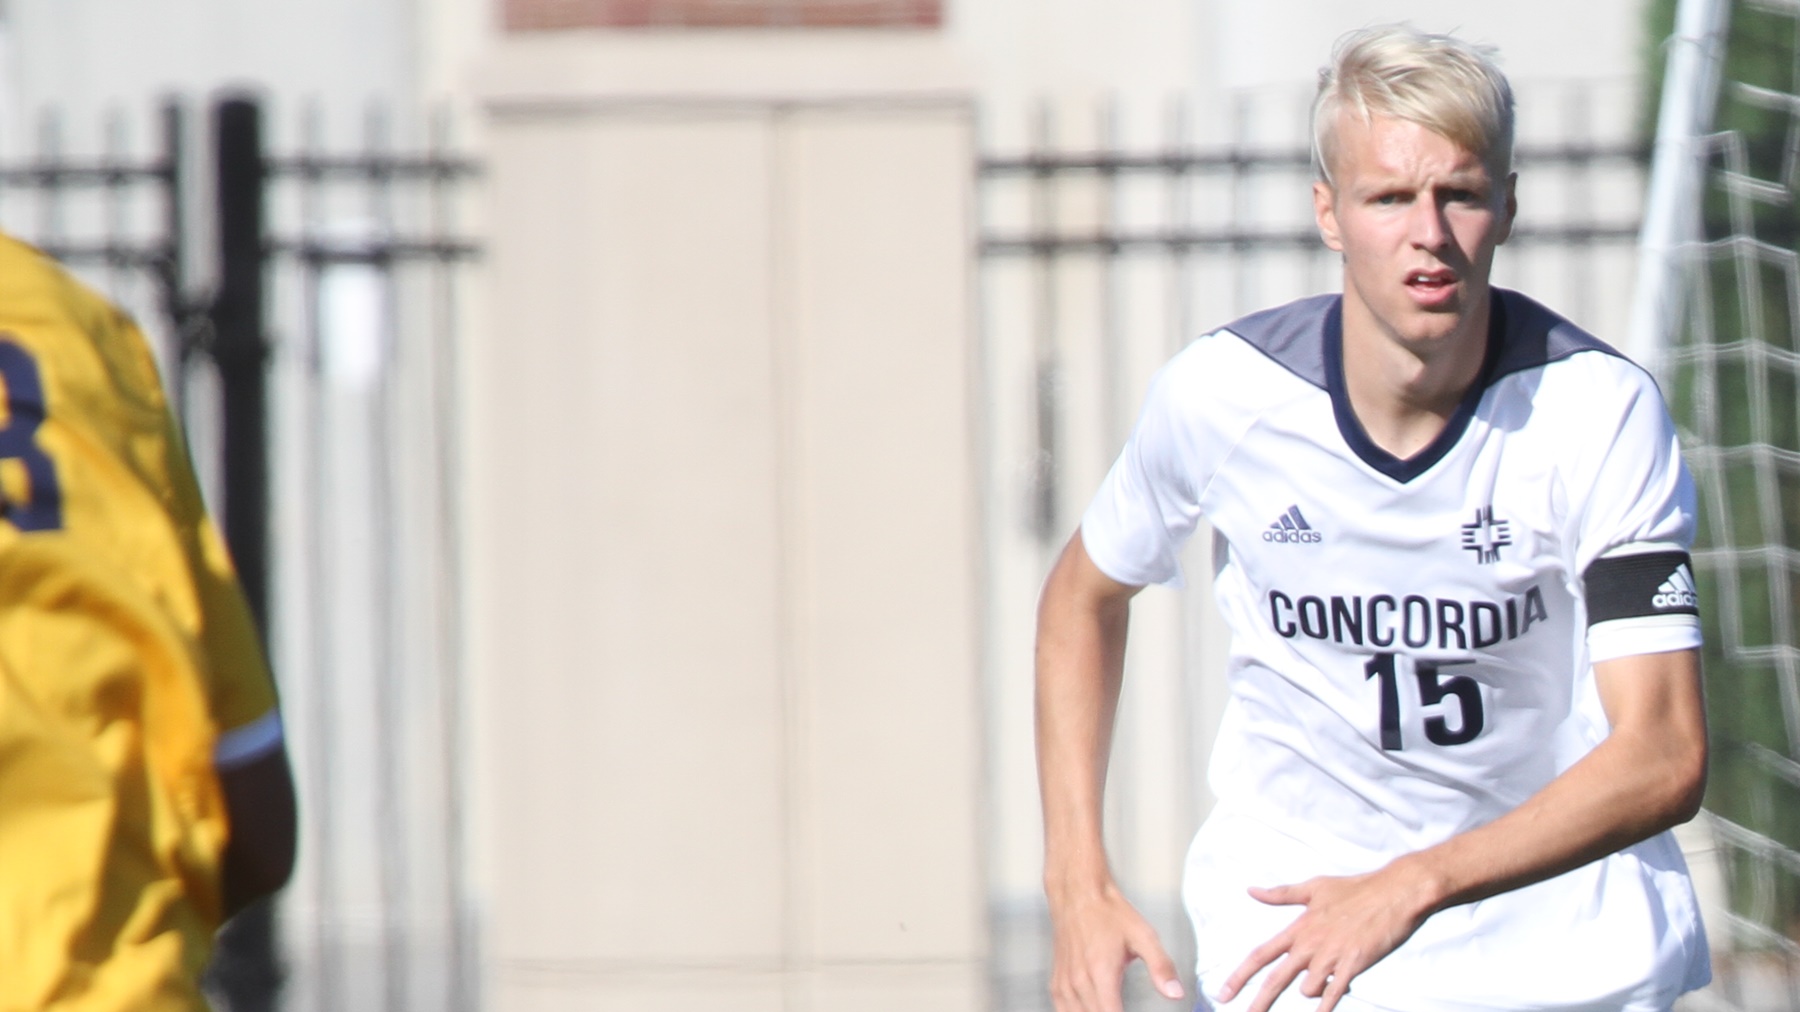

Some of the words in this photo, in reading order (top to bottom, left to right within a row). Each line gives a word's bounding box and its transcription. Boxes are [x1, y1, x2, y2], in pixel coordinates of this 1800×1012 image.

[1262, 530, 1322, 543] adidas
[1269, 584, 1548, 650] CONCORDIA
[1652, 592, 1698, 608] adid
[1364, 652, 1484, 751] 15
